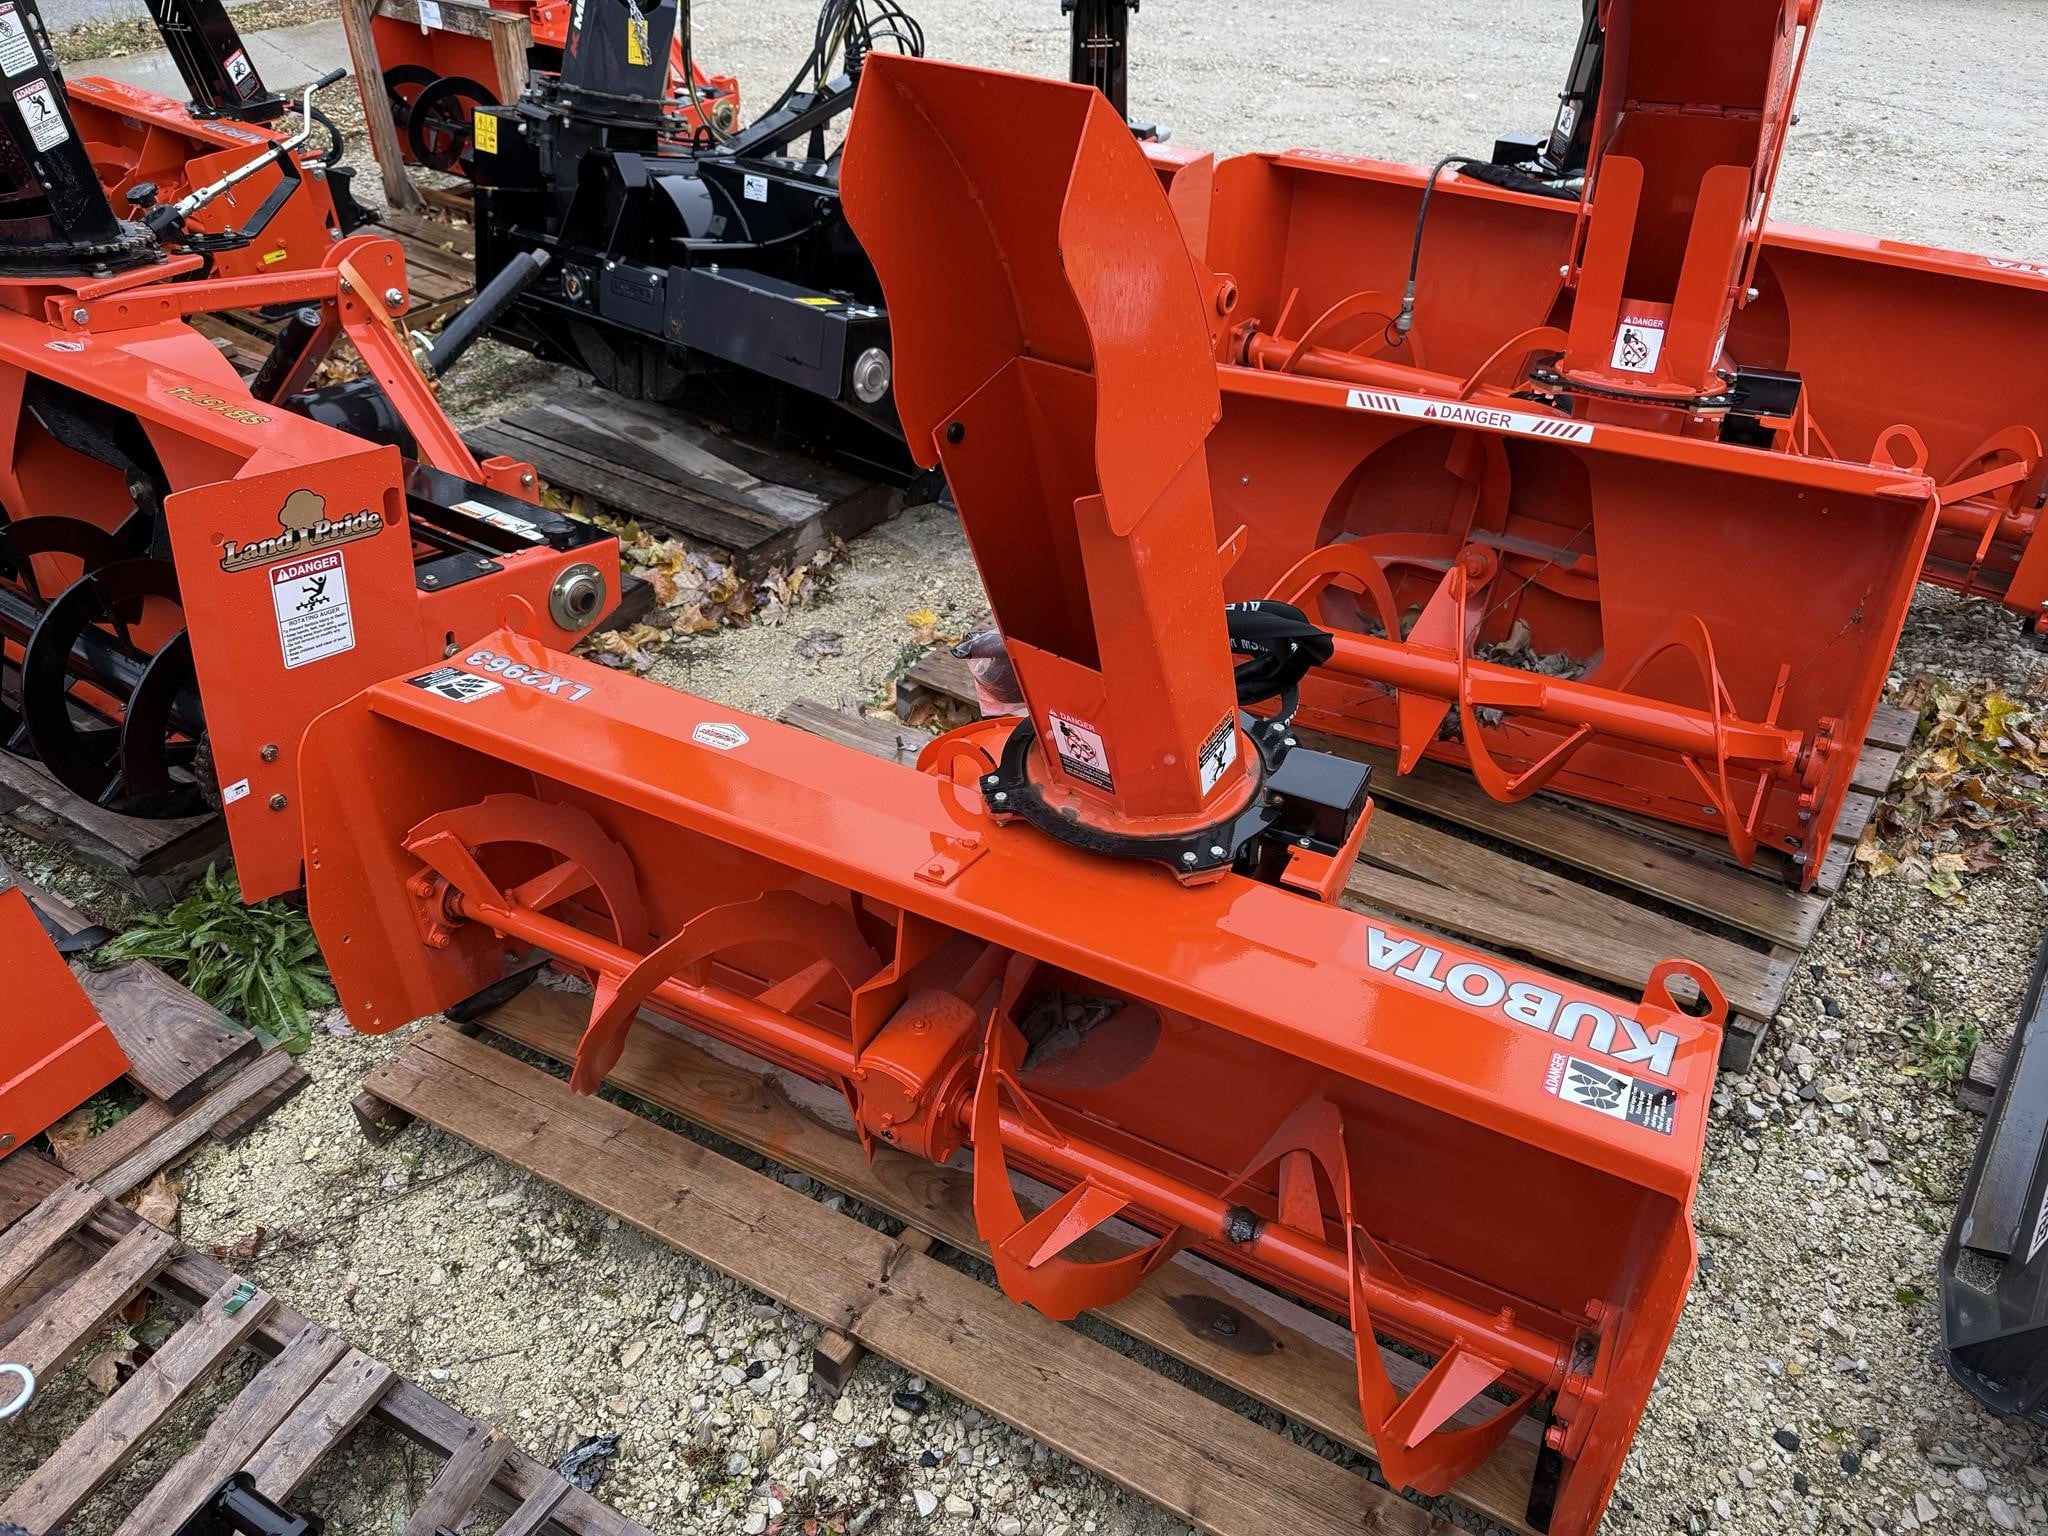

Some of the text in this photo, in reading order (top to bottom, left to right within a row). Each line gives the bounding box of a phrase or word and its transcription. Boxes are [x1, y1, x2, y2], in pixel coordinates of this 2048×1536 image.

[20, 81, 46, 97] DANGER
[1631, 316, 1664, 328] DANGER
[164, 386, 272, 425] SB1574
[1440, 406, 1512, 428] DANGER
[224, 513, 383, 566] Land Pride
[287, 555, 339, 579] DANGER
[288, 607, 341, 626] ROTATING AUGER
[464, 650, 593, 702] LX2963
[1059, 712, 1096, 732] DANGER
[1367, 925, 1679, 1076] KUBOTA
[1549, 1052, 1566, 1087] DANGER
